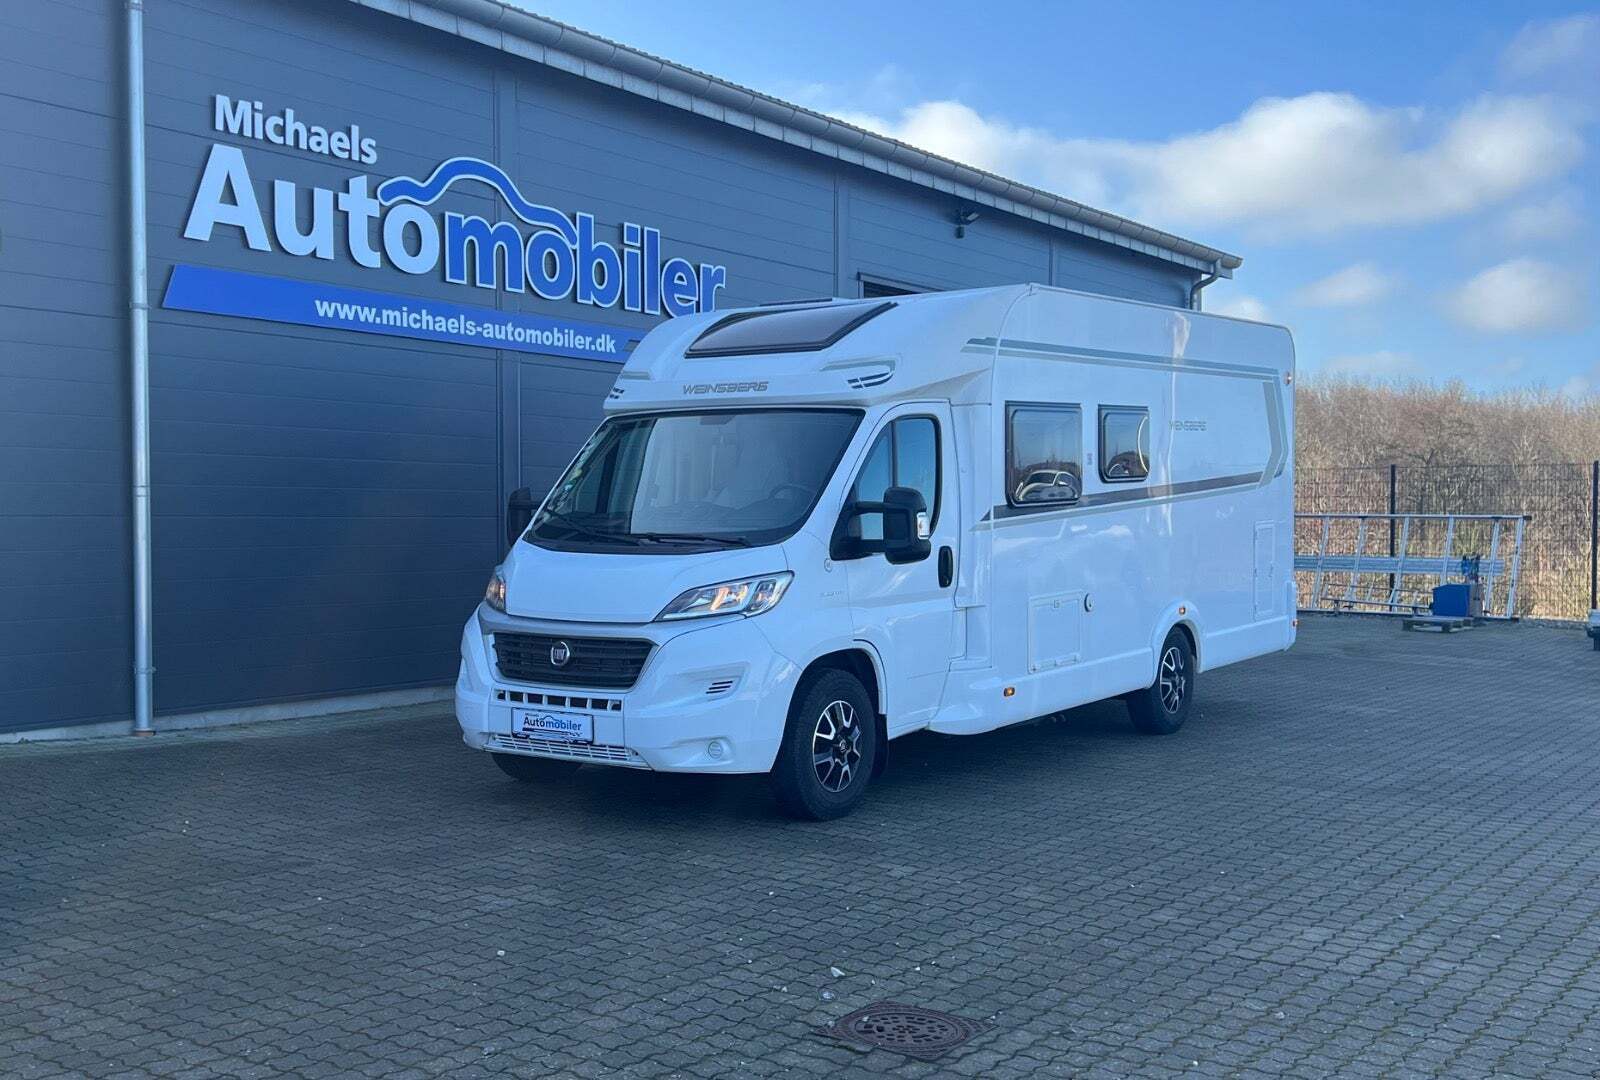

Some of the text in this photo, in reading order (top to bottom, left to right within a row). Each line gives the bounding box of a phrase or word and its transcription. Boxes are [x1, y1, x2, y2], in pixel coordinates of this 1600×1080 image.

[214, 94, 378, 165] Michaels
[183, 143, 727, 319] Automobiler
[314, 299, 617, 354] www.michaels-automobiler.dk
[682, 380, 769, 395] WEINSBERG
[523, 716, 582, 731] Automobiler
